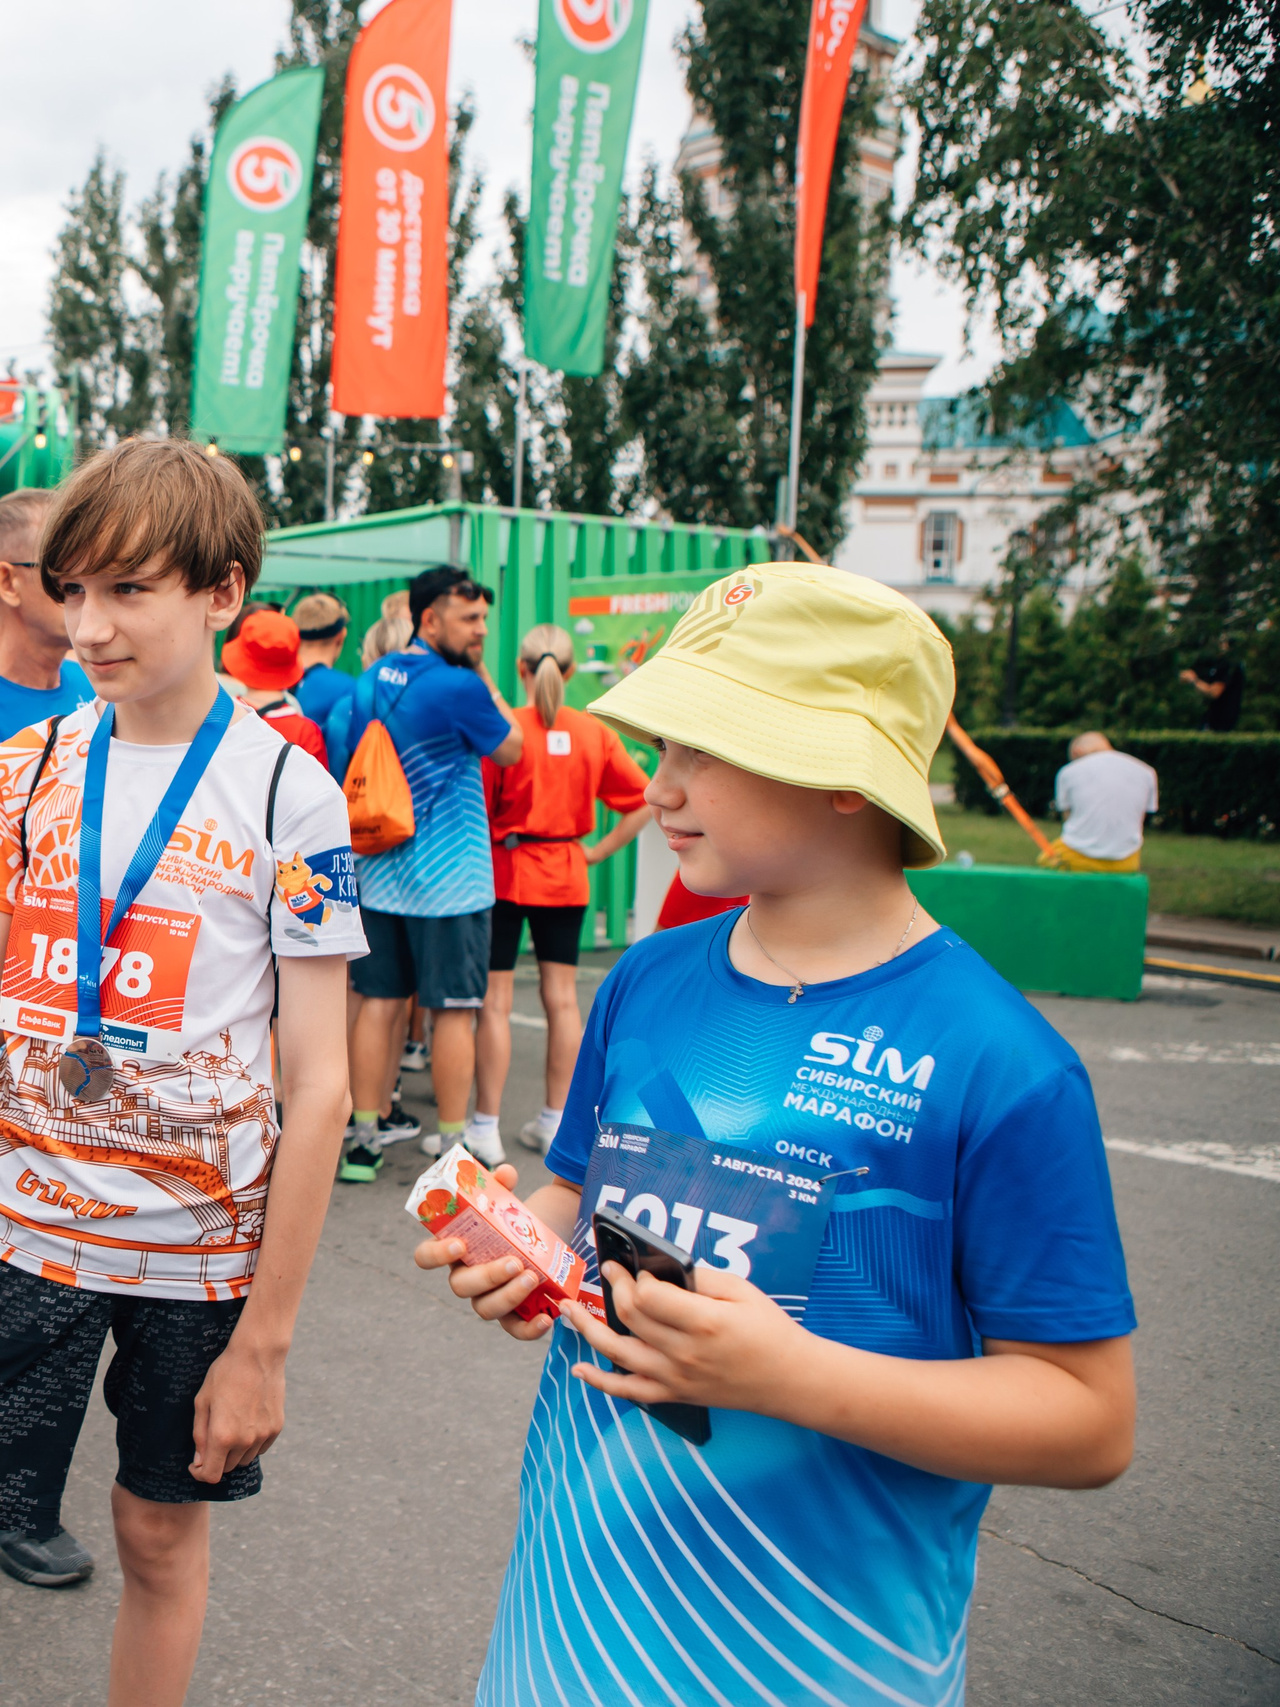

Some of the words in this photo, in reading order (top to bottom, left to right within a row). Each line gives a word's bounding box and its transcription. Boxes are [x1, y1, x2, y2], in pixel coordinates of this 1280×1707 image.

[376, 207, 402, 245] 30
[130, 913, 169, 926] АВГУСТА
[170, 919, 192, 930] 2024
[169, 928, 176, 937] 10
[177, 930, 189, 938] КМ
[31, 932, 154, 999] 1878
[20, 1013, 42, 1026] Альфа
[42, 1017, 62, 1029] Банк
[101, 1032, 144, 1048] ледопыт
[796, 1066, 923, 1113] СИБИРСКИЙ
[790, 1081, 917, 1125] МЕЖДУНАРОДНЫЙ
[783, 1091, 913, 1144] МАРАФОН
[619, 1142, 647, 1155] МАРАФОН
[775, 1140, 833, 1168] ОМСК
[712, 1154, 721, 1166] 3
[722, 1156, 783, 1183] АВГУСТА
[785, 1176, 822, 1194] 2024
[788, 1190, 796, 1200] 3
[797, 1192, 817, 1205] КМ
[586, 1301, 606, 1320] Банк
